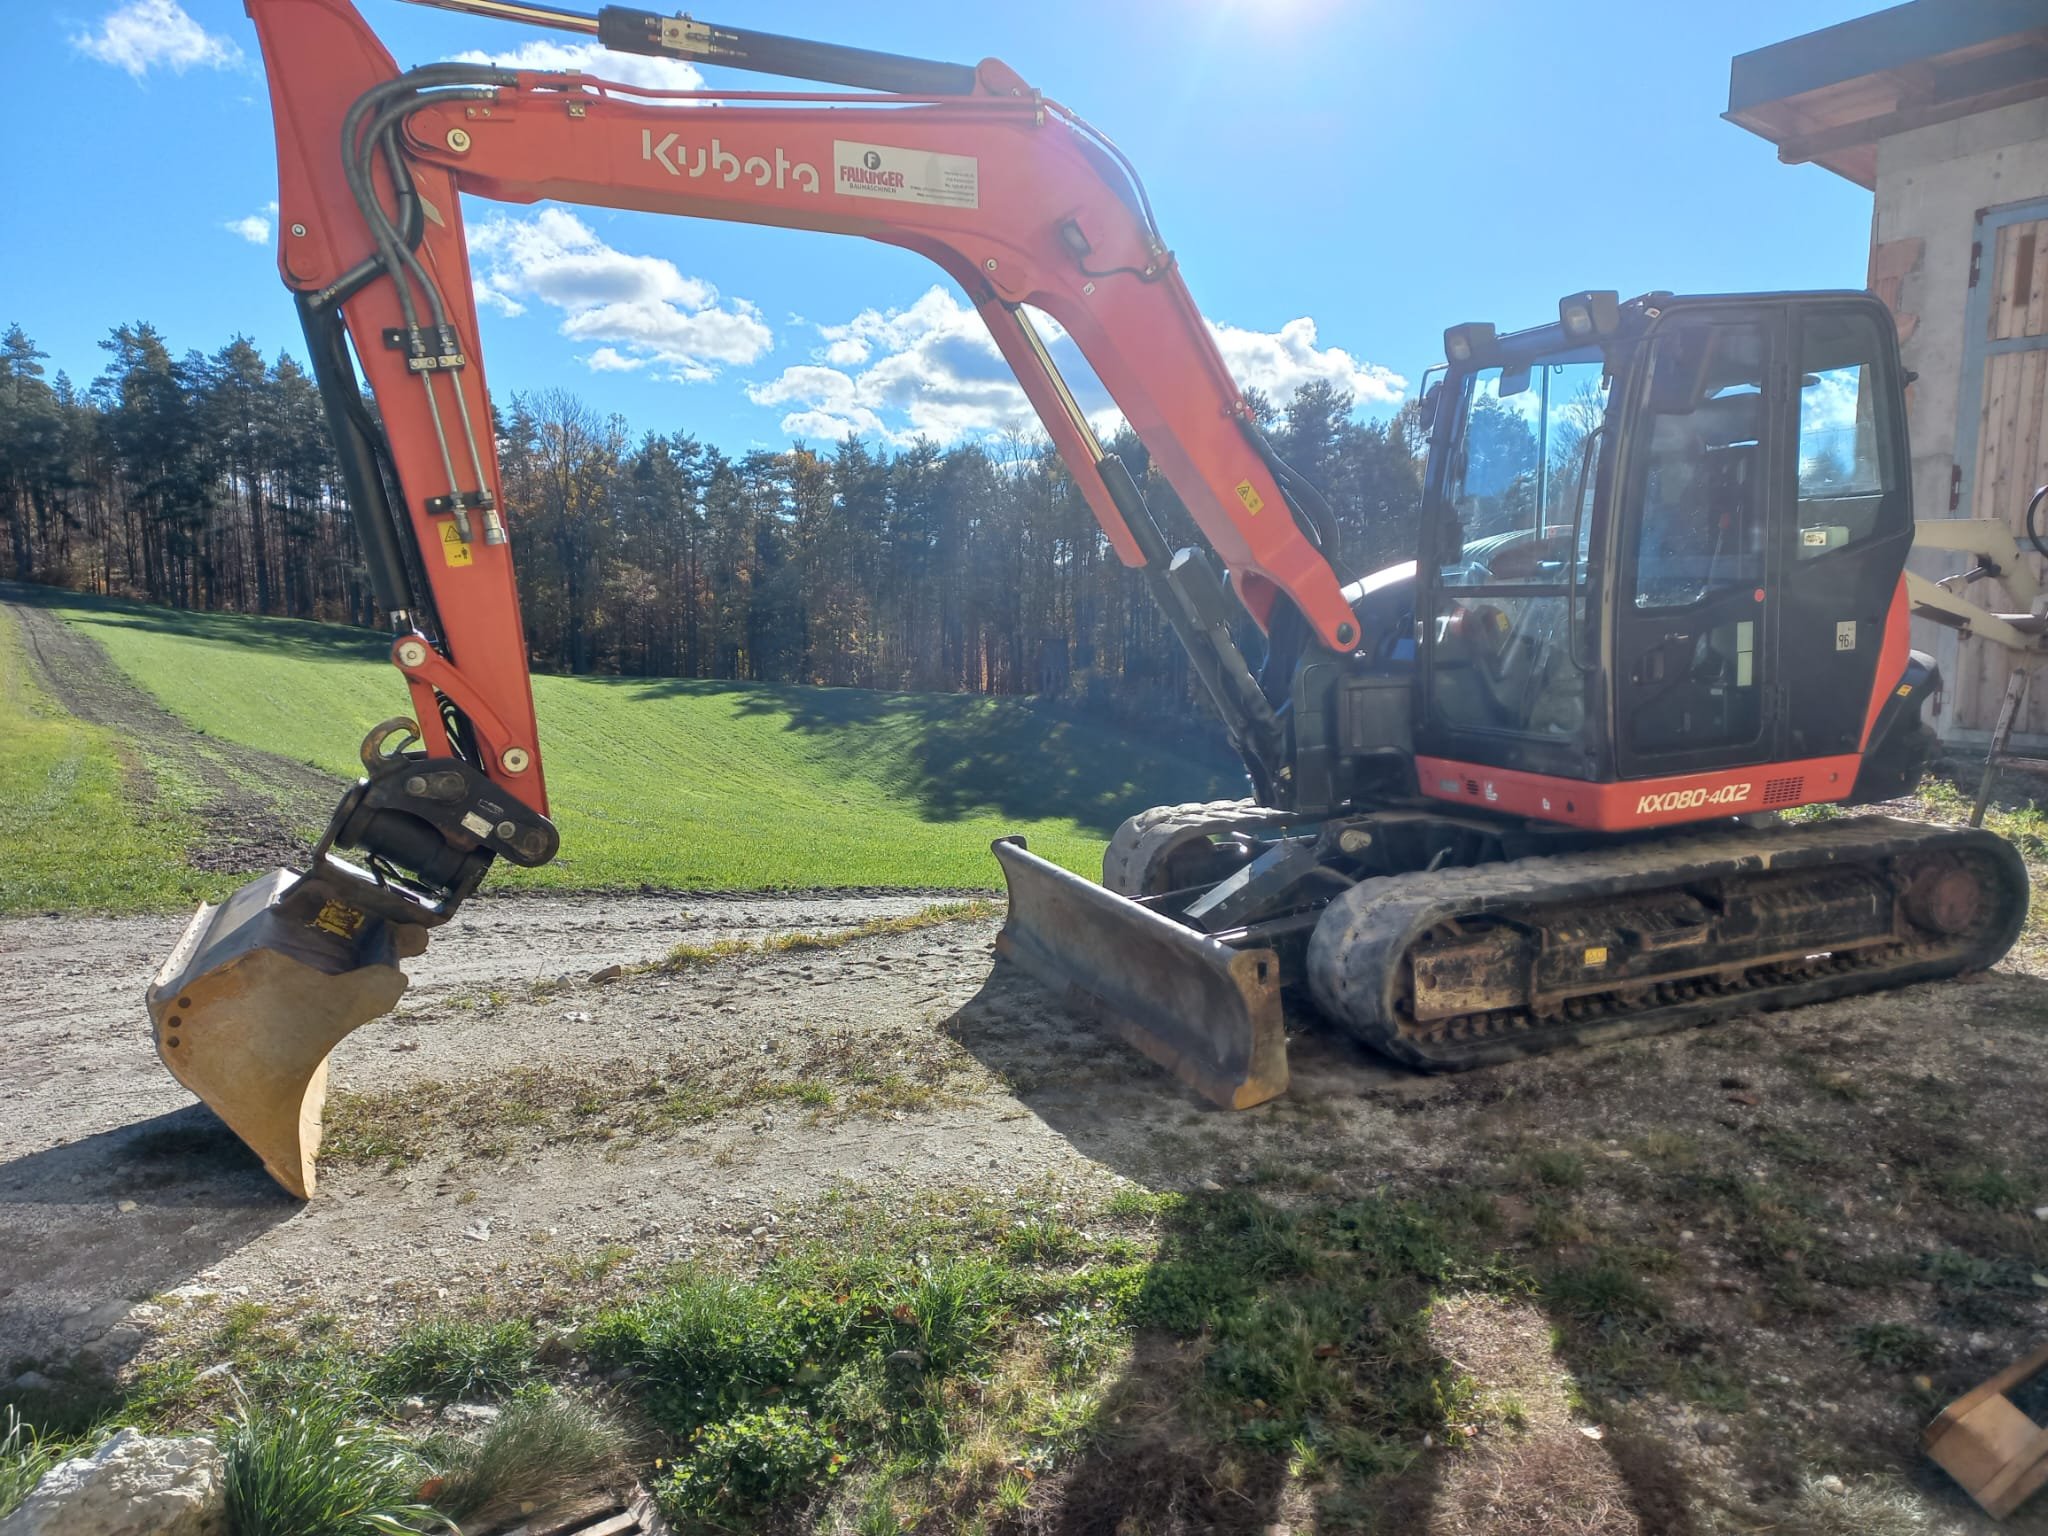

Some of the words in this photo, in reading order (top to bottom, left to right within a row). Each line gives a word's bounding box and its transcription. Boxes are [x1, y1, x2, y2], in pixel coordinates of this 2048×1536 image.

[642, 129, 820, 194] Kubota
[840, 165, 905, 188] FALKINGER
[849, 182, 897, 194] BAUMASCHINEN
